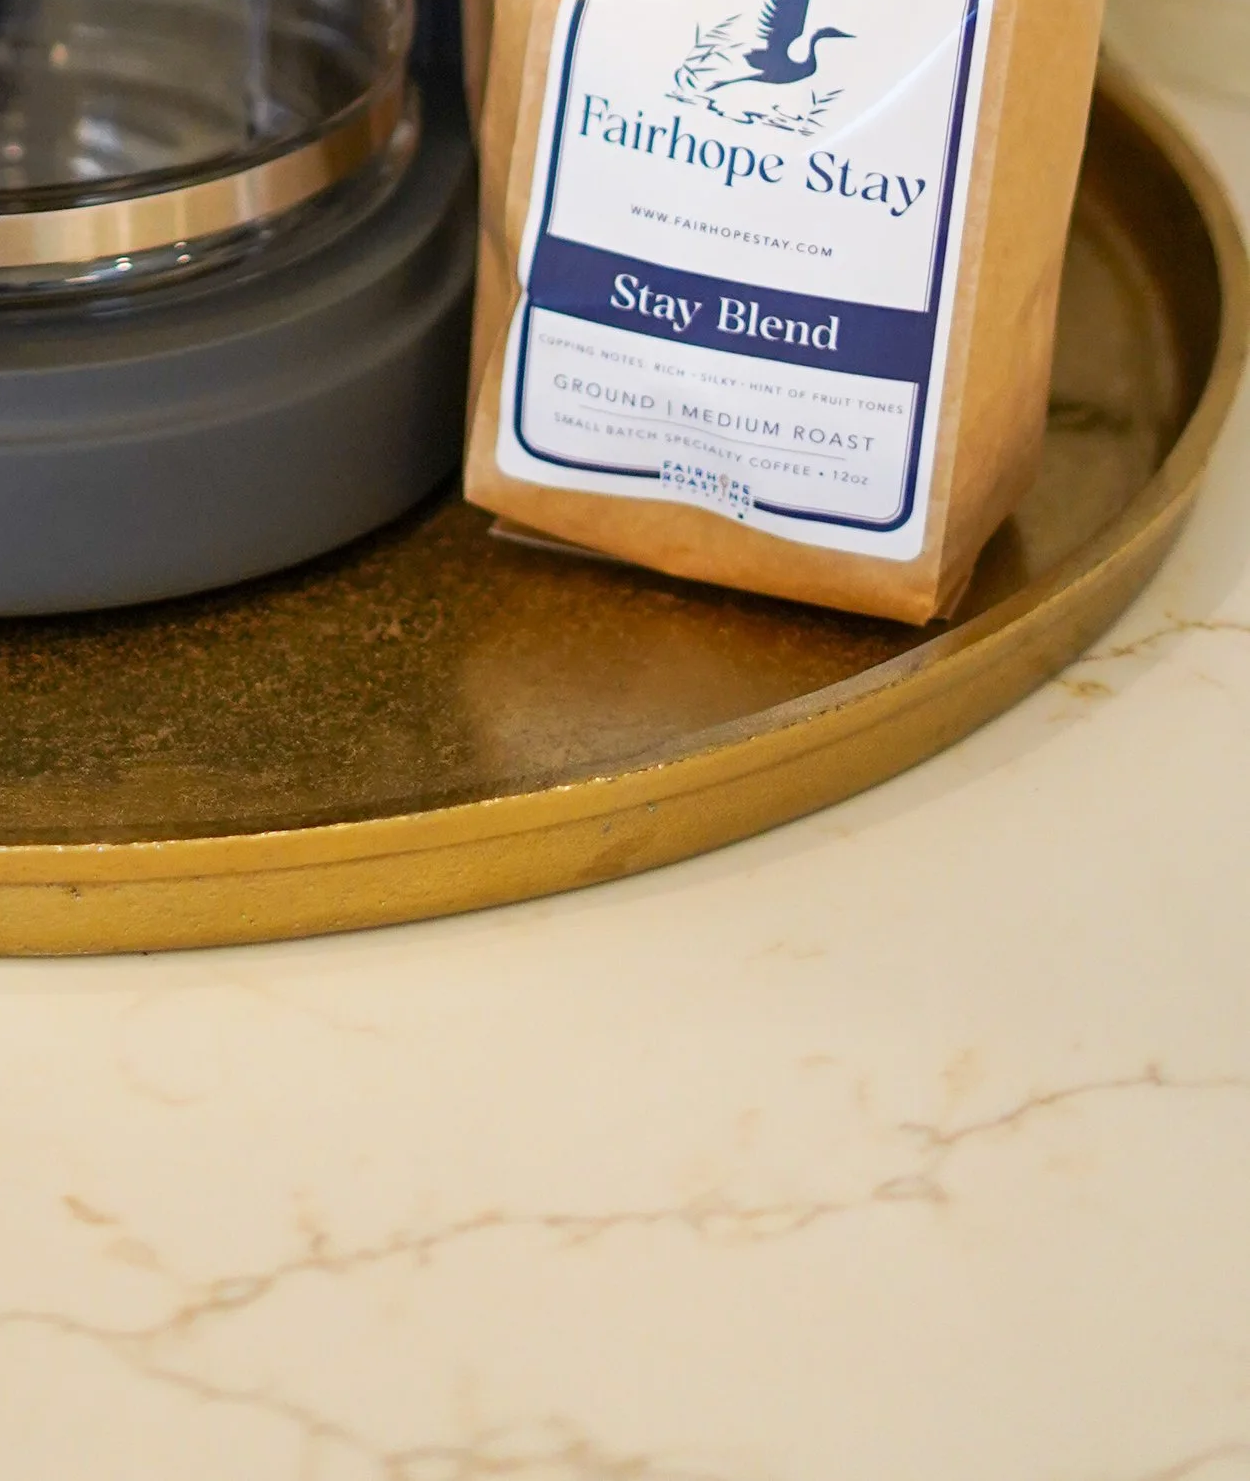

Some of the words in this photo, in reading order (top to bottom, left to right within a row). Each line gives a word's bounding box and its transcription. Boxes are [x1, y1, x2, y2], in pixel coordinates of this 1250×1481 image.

[579, 93, 785, 188] Fairhope
[805, 150, 927, 218] Stay
[630, 203, 835, 258] WWW.FAIRHOPESTAY.COM
[610, 272, 702, 333] Stay
[717, 295, 841, 351] Blend
[538, 332, 596, 357] CUPPING
[653, 361, 686, 377] RICH
[749, 380, 782, 396] HINT
[787, 388, 806, 400] OF
[812, 392, 852, 408] FRUIT
[858, 399, 905, 416] TONES
[553, 372, 656, 410] GROUND
[682, 403, 781, 438] MEDIUM
[793, 425, 876, 453] ROAST
[553, 411, 601, 434] SMALL
[606, 424, 659, 442] BATCH
[664, 432, 744, 463] SPECIALTY
[749, 456, 812, 478] COFFEE
